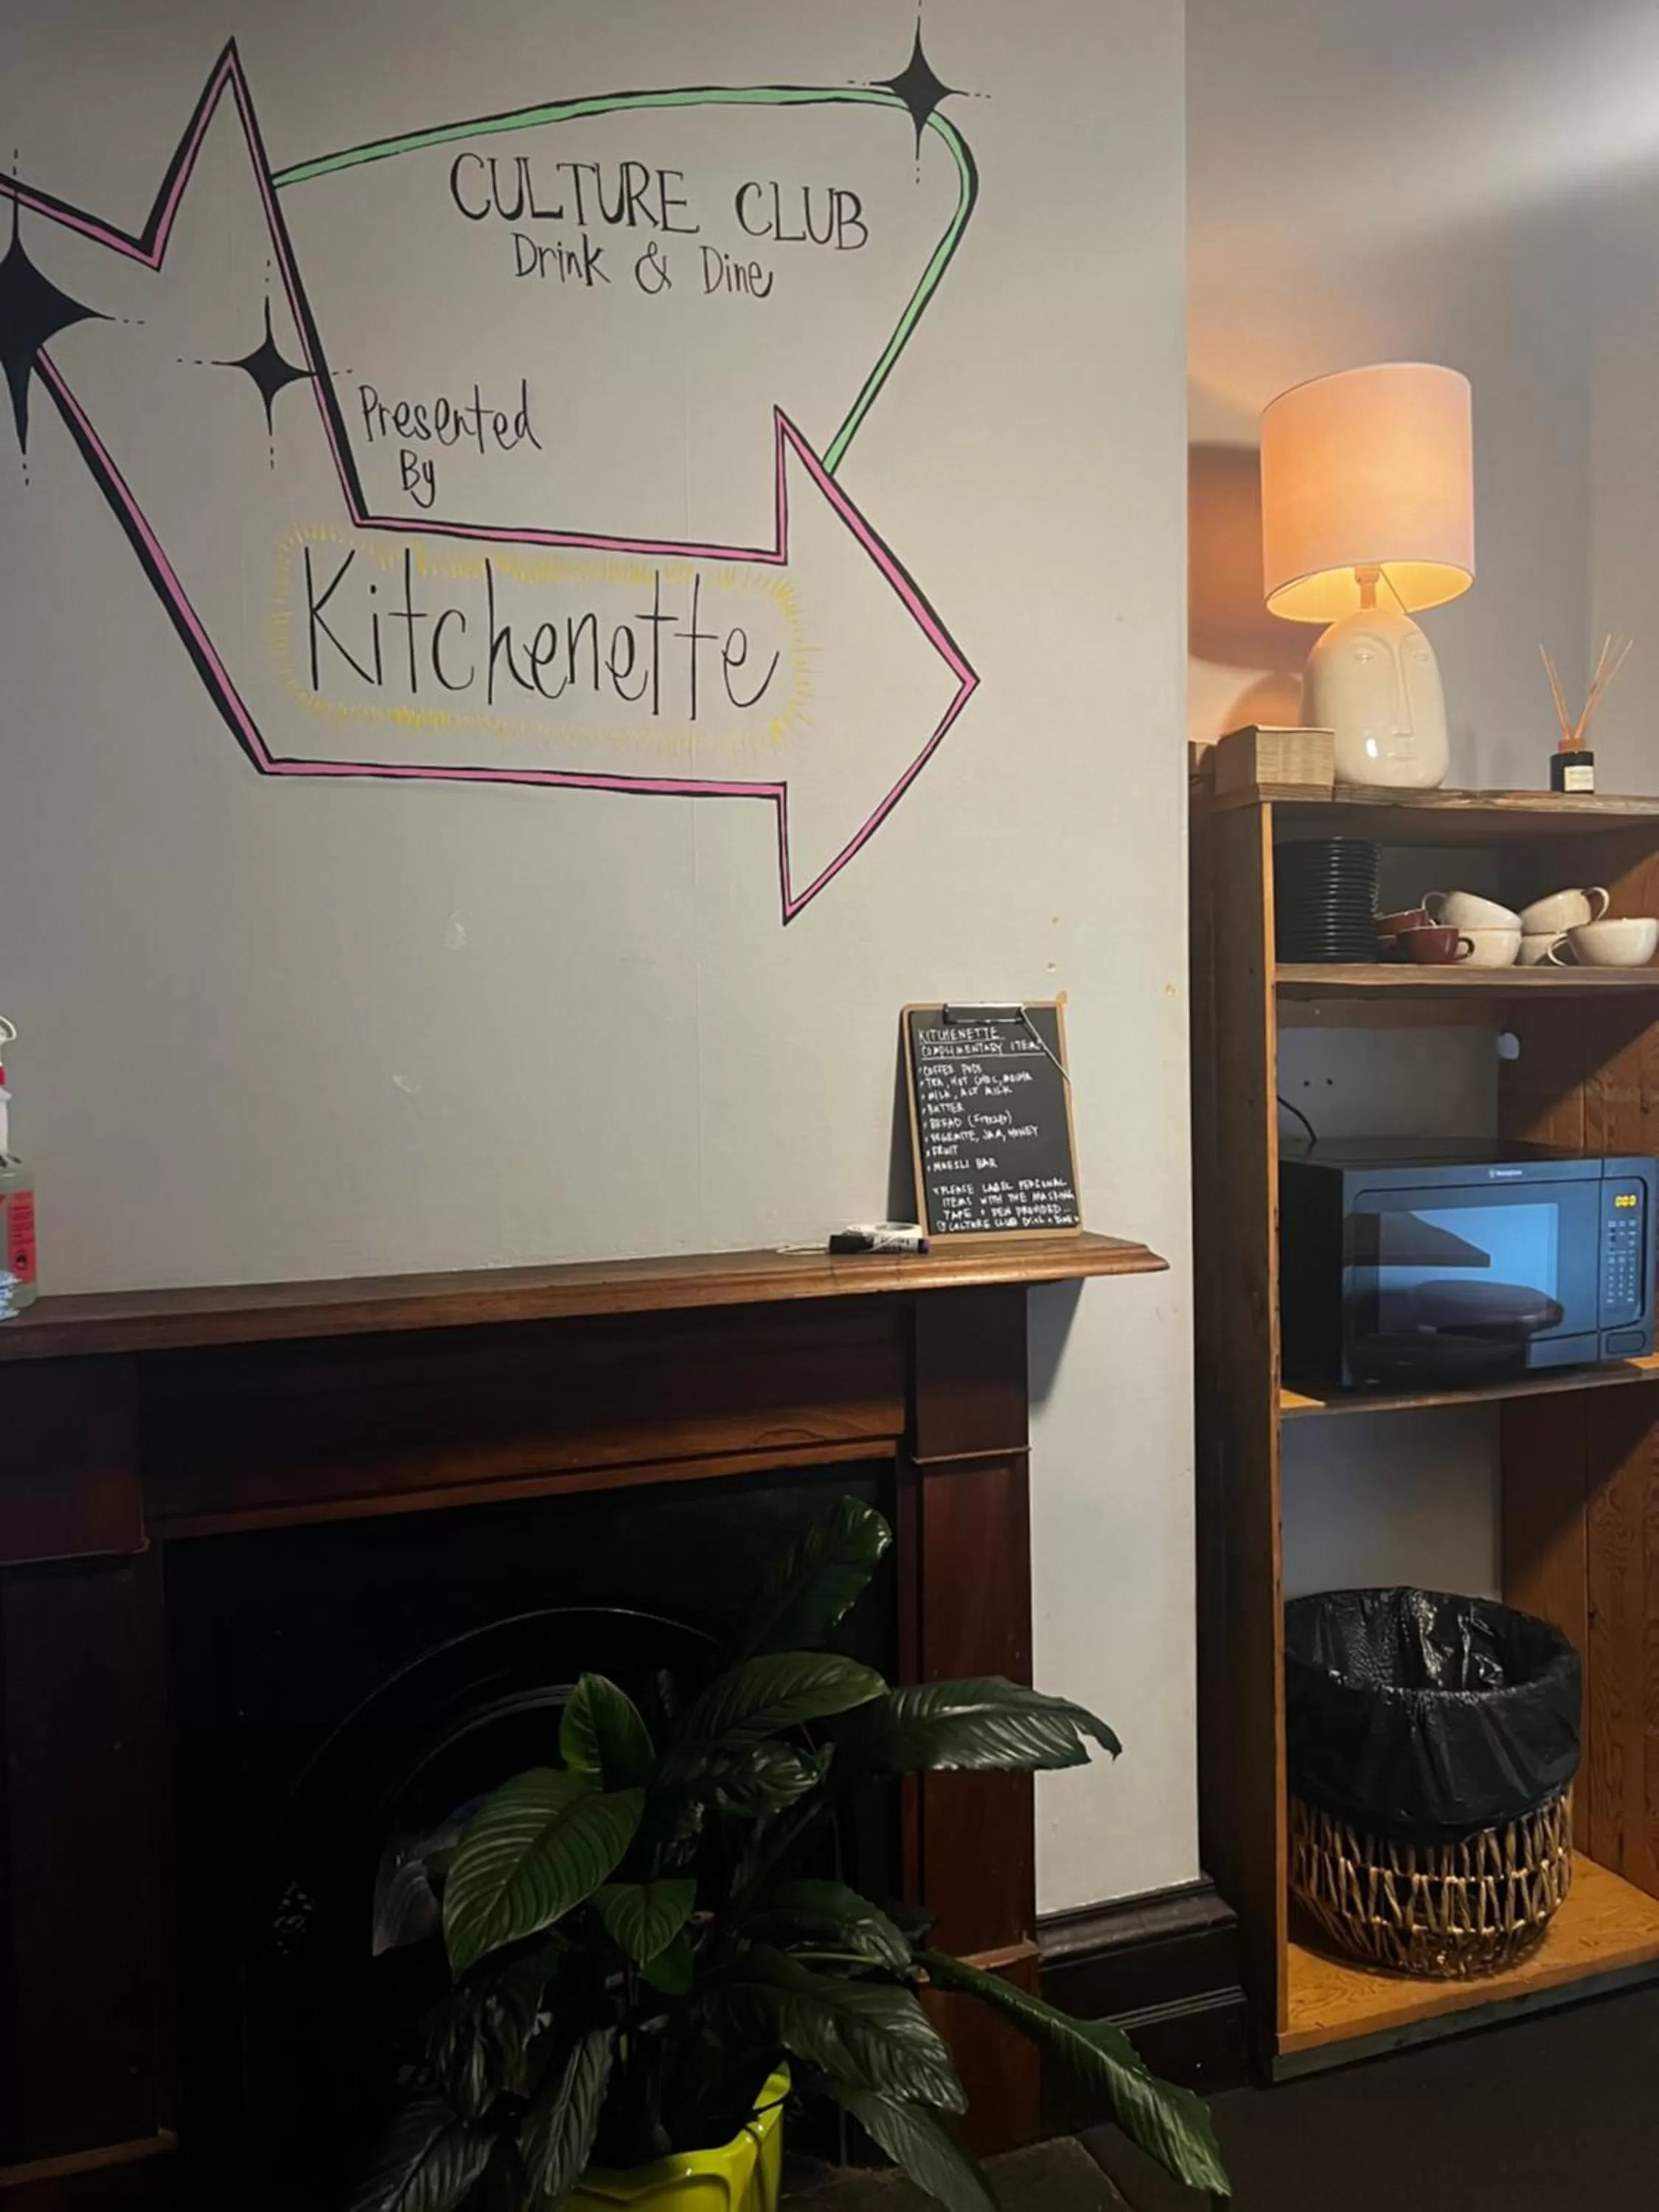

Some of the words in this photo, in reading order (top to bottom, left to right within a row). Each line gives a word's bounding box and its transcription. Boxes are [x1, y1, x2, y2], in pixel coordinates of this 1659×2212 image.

[450, 152, 700, 234] CULTURE
[735, 181, 869, 250] CLUB
[512, 232, 611, 287] Drink
[635, 240, 672, 294] &
[699, 245, 773, 298] Dine
[358, 378, 543, 455] Presented
[400, 448, 436, 509] By
[304, 546, 780, 720] Kitchenette
[918, 1026, 1001, 1043] KITCHENETTE
[929, 1116, 962, 1130] BREAD
[975, 1156, 998, 1170] BAR
[1007, 1191, 1028, 1203] THE
